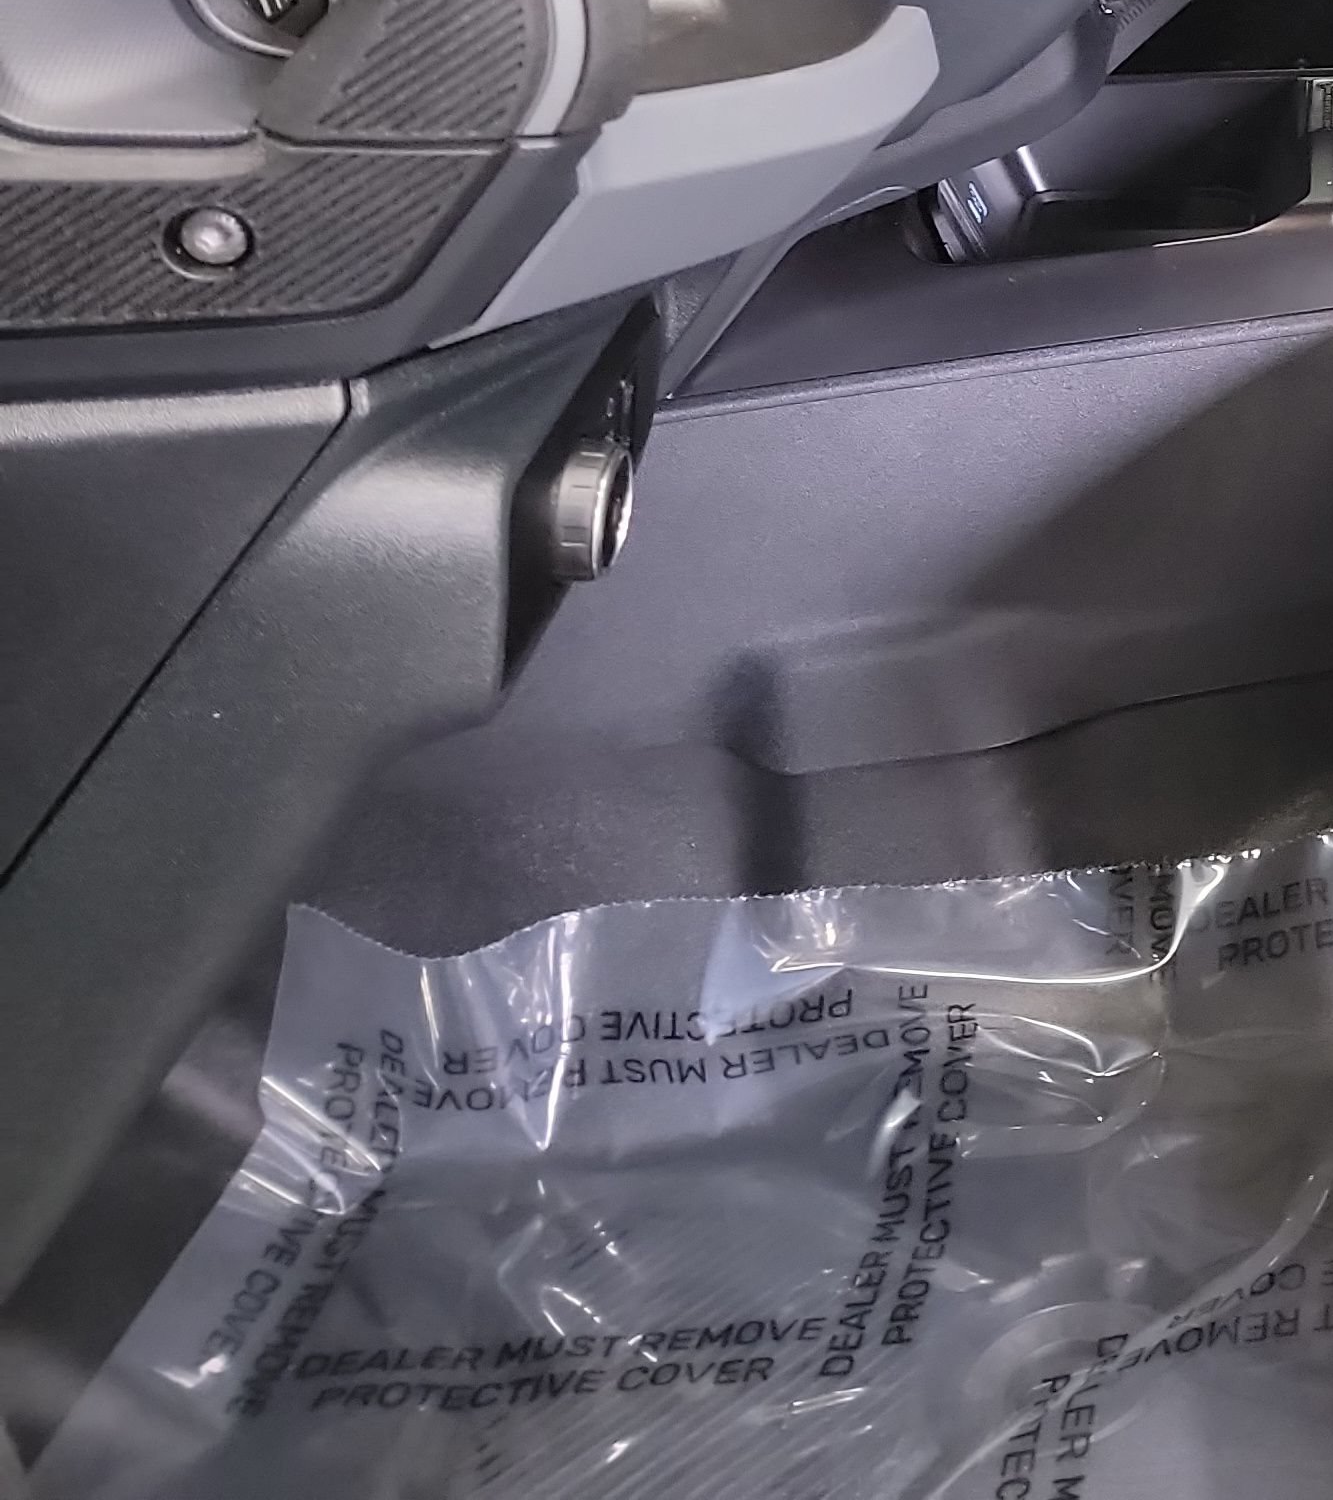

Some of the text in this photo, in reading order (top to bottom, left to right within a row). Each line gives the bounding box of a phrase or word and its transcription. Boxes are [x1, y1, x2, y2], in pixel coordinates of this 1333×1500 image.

[601, 1057, 707, 1085] MUST
[721, 1028, 891, 1079] DEALER
[881, 1002, 977, 1346] PROTECTIVE COVER
[820, 1250, 891, 1377] DEALER
[871, 1144, 916, 1243] MUST
[195, 1269, 282, 1368] COVE
[297, 1316, 828, 1381] DEALER MUST REMOVE
[309, 1355, 775, 1413] PROTECTIVE COVER
